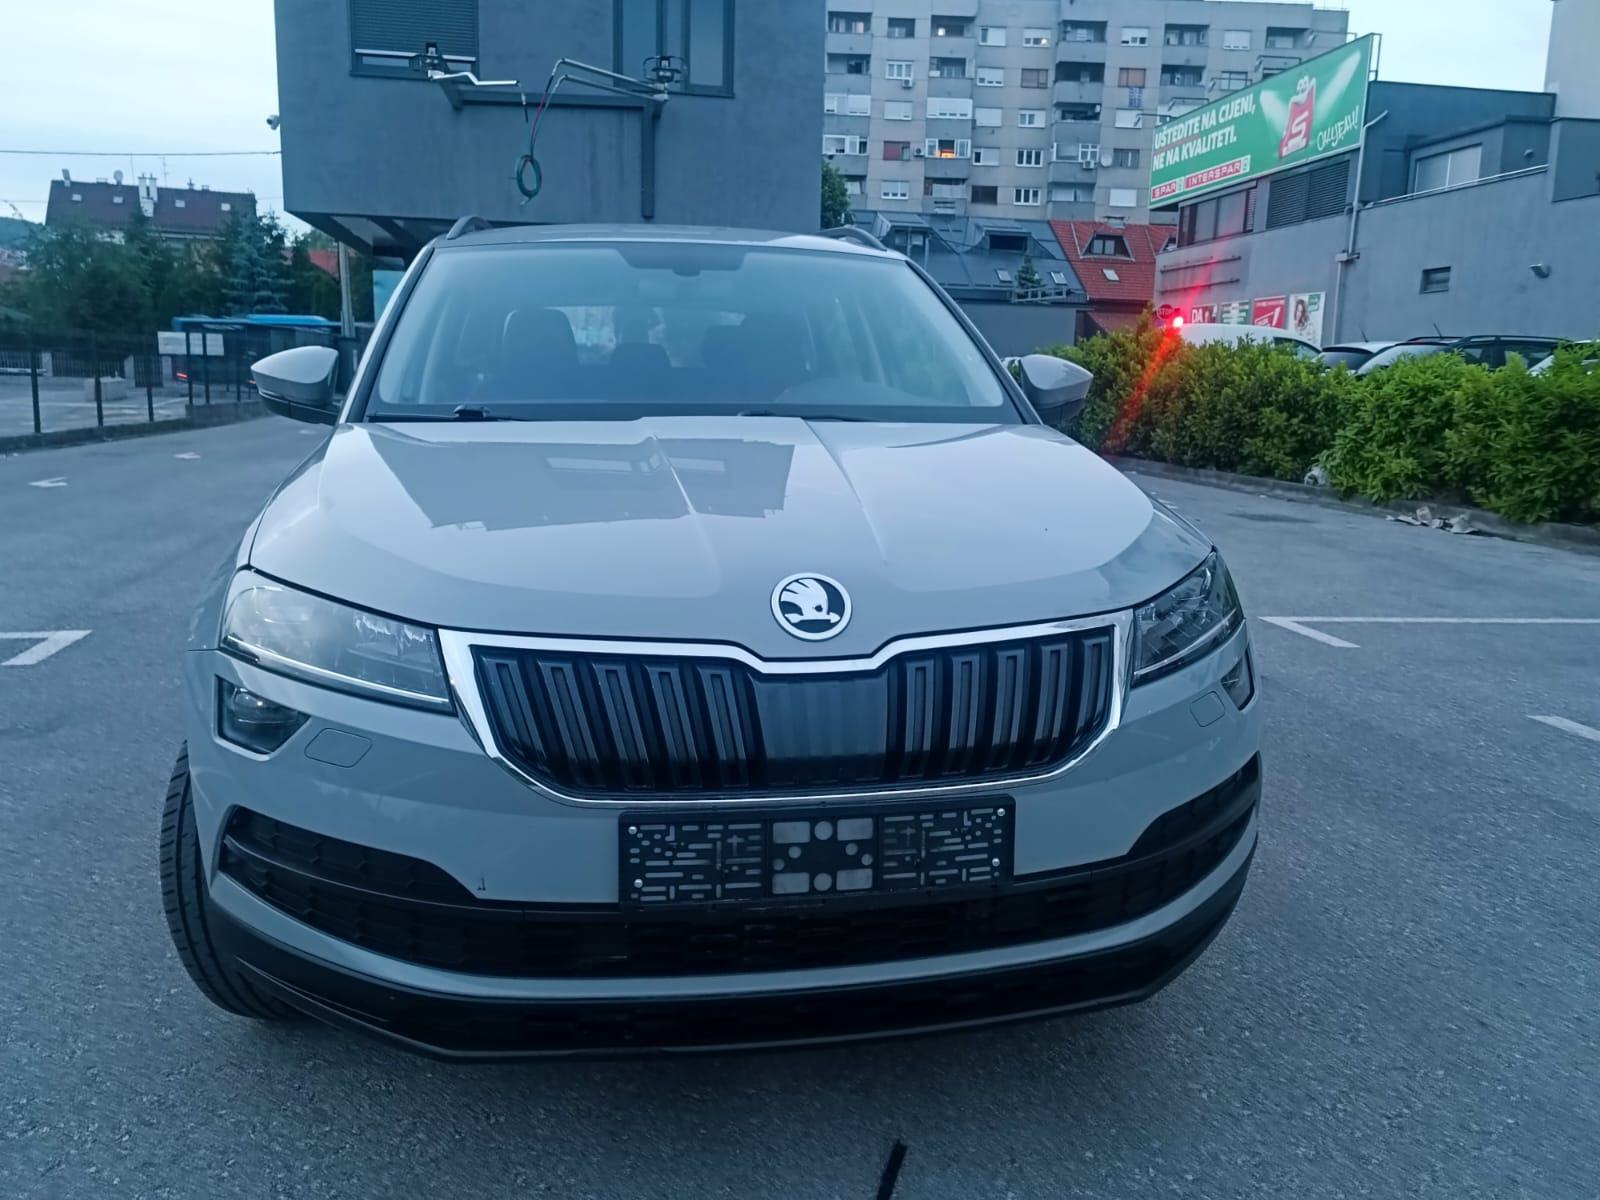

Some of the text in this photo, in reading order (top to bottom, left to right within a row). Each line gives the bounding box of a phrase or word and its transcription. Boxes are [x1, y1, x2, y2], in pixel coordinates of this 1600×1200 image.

[1155, 93, 1256, 149] UŠTEDITE NA CIJENI,
[1153, 125, 1237, 172] NE NA KVALITETI.
[1154, 182, 1176, 198] SPAR
[1188, 162, 1241, 186] INTERSPAR
